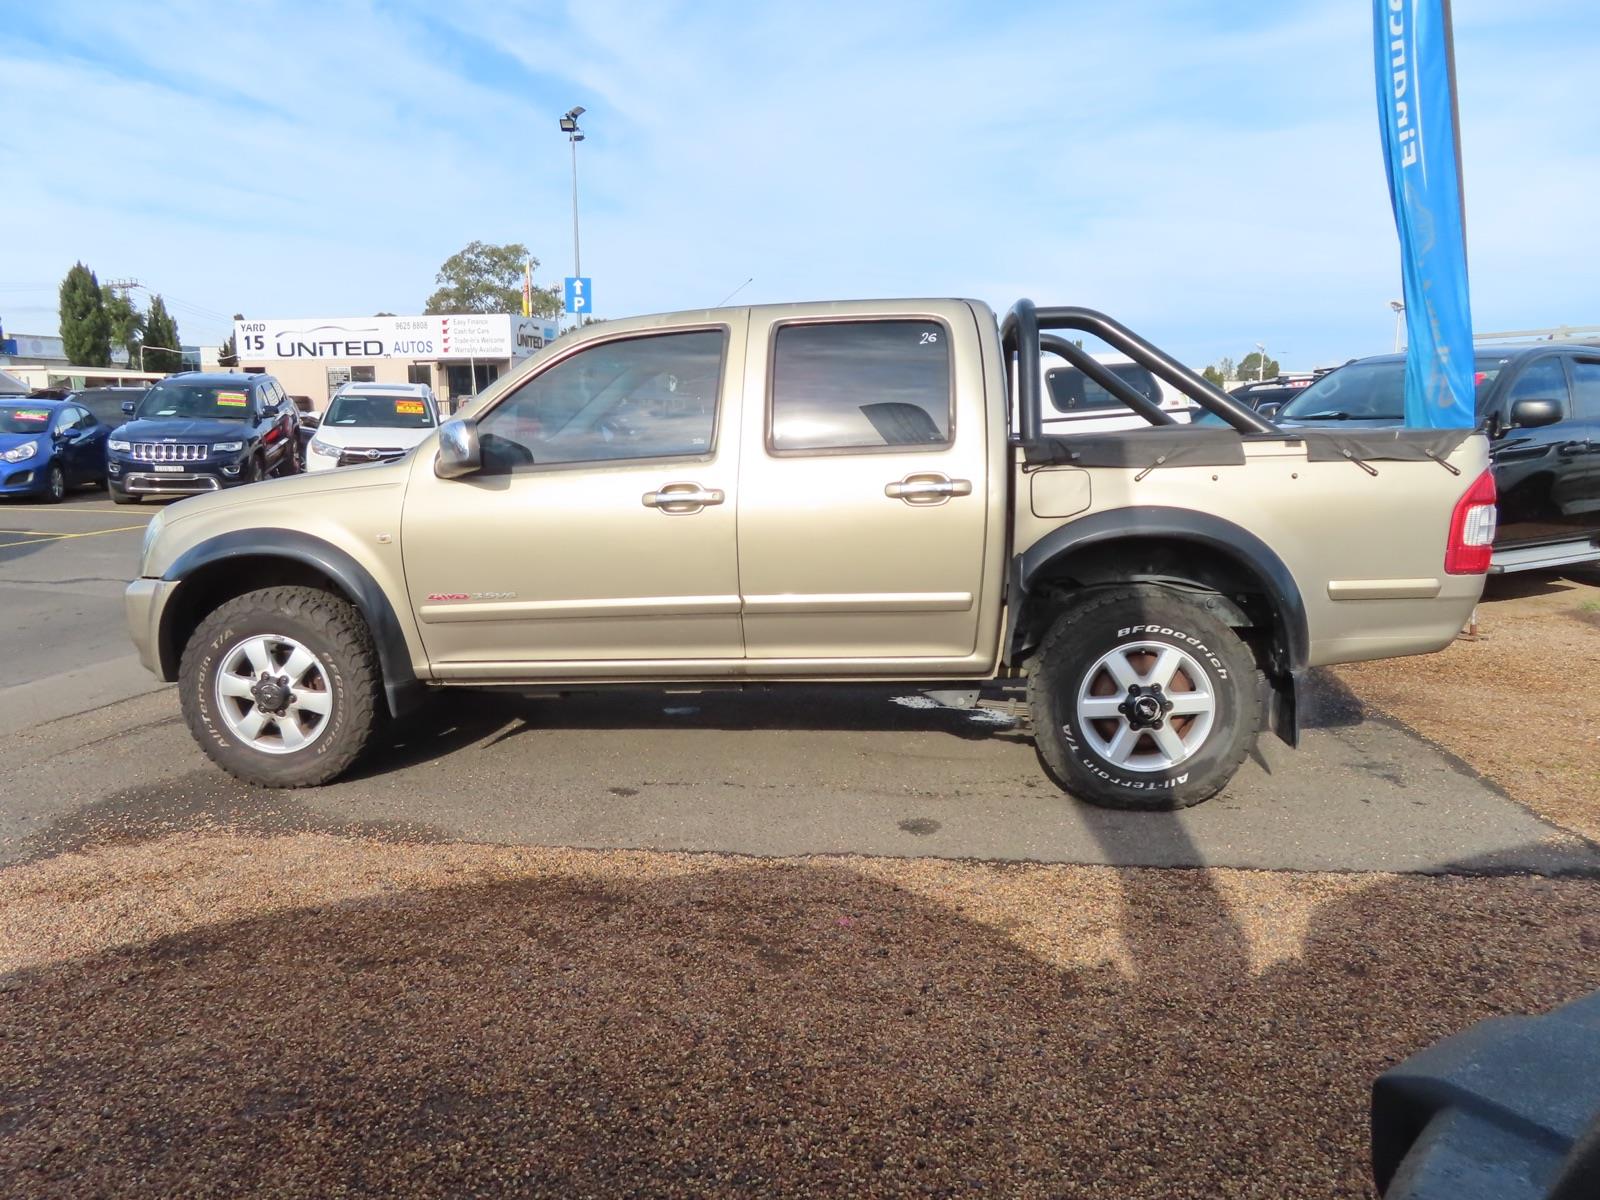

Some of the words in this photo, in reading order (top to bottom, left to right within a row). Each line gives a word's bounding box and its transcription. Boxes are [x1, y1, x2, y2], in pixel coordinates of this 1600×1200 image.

[574, 297, 584, 312] P
[241, 323, 266, 333] YARD
[244, 335, 265, 350] 15
[919, 332, 937, 345] 26
[393, 340, 433, 354] AUTOS
[1117, 624, 1228, 680] BFGoodrich
[1062, 723, 1080, 753] T/A
[1083, 758, 1190, 790] All-Terrain
